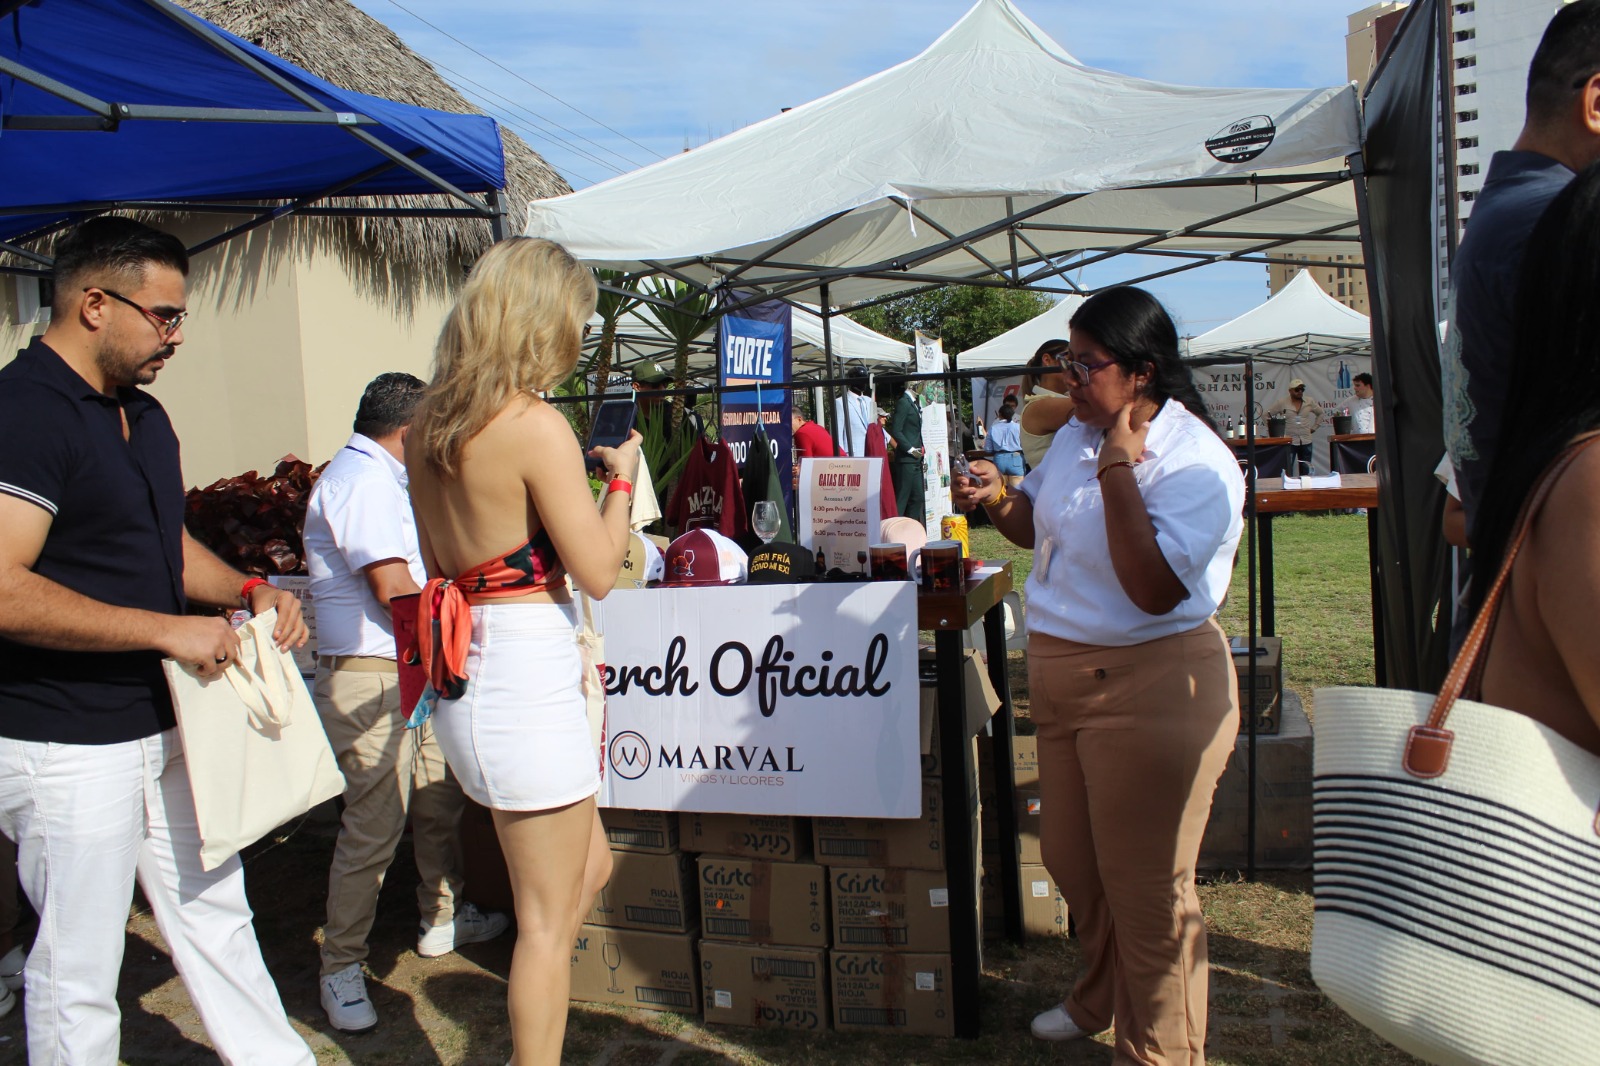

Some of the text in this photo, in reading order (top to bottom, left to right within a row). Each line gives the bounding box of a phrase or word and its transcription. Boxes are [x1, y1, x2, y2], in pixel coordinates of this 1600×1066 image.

[727, 335, 774, 376] FORTE
[1197, 381, 1276, 392] SHANON
[743, 411, 781, 425] AUTOMTIZADA
[818, 473, 861, 487] CATAS DE VINO
[772, 553, 790, 565] FRÍA
[606, 633, 891, 717] erch Oficial
[658, 745, 805, 772] MARVAL
[680, 773, 785, 786] VINOS Y LICORES
[733, 833, 791, 856] Crist
[650, 889, 679, 899] RIOJA
[704, 892, 745, 901] 5412AL24
[837, 901, 881, 909] 5412AL24
[838, 909, 867, 917] RIOJA
[661, 970, 690, 980] RIOJA
[837, 982, 881, 990] 5412AL24
[788, 988, 817, 997] RIOJA
[837, 990, 866, 998] RIOJA
